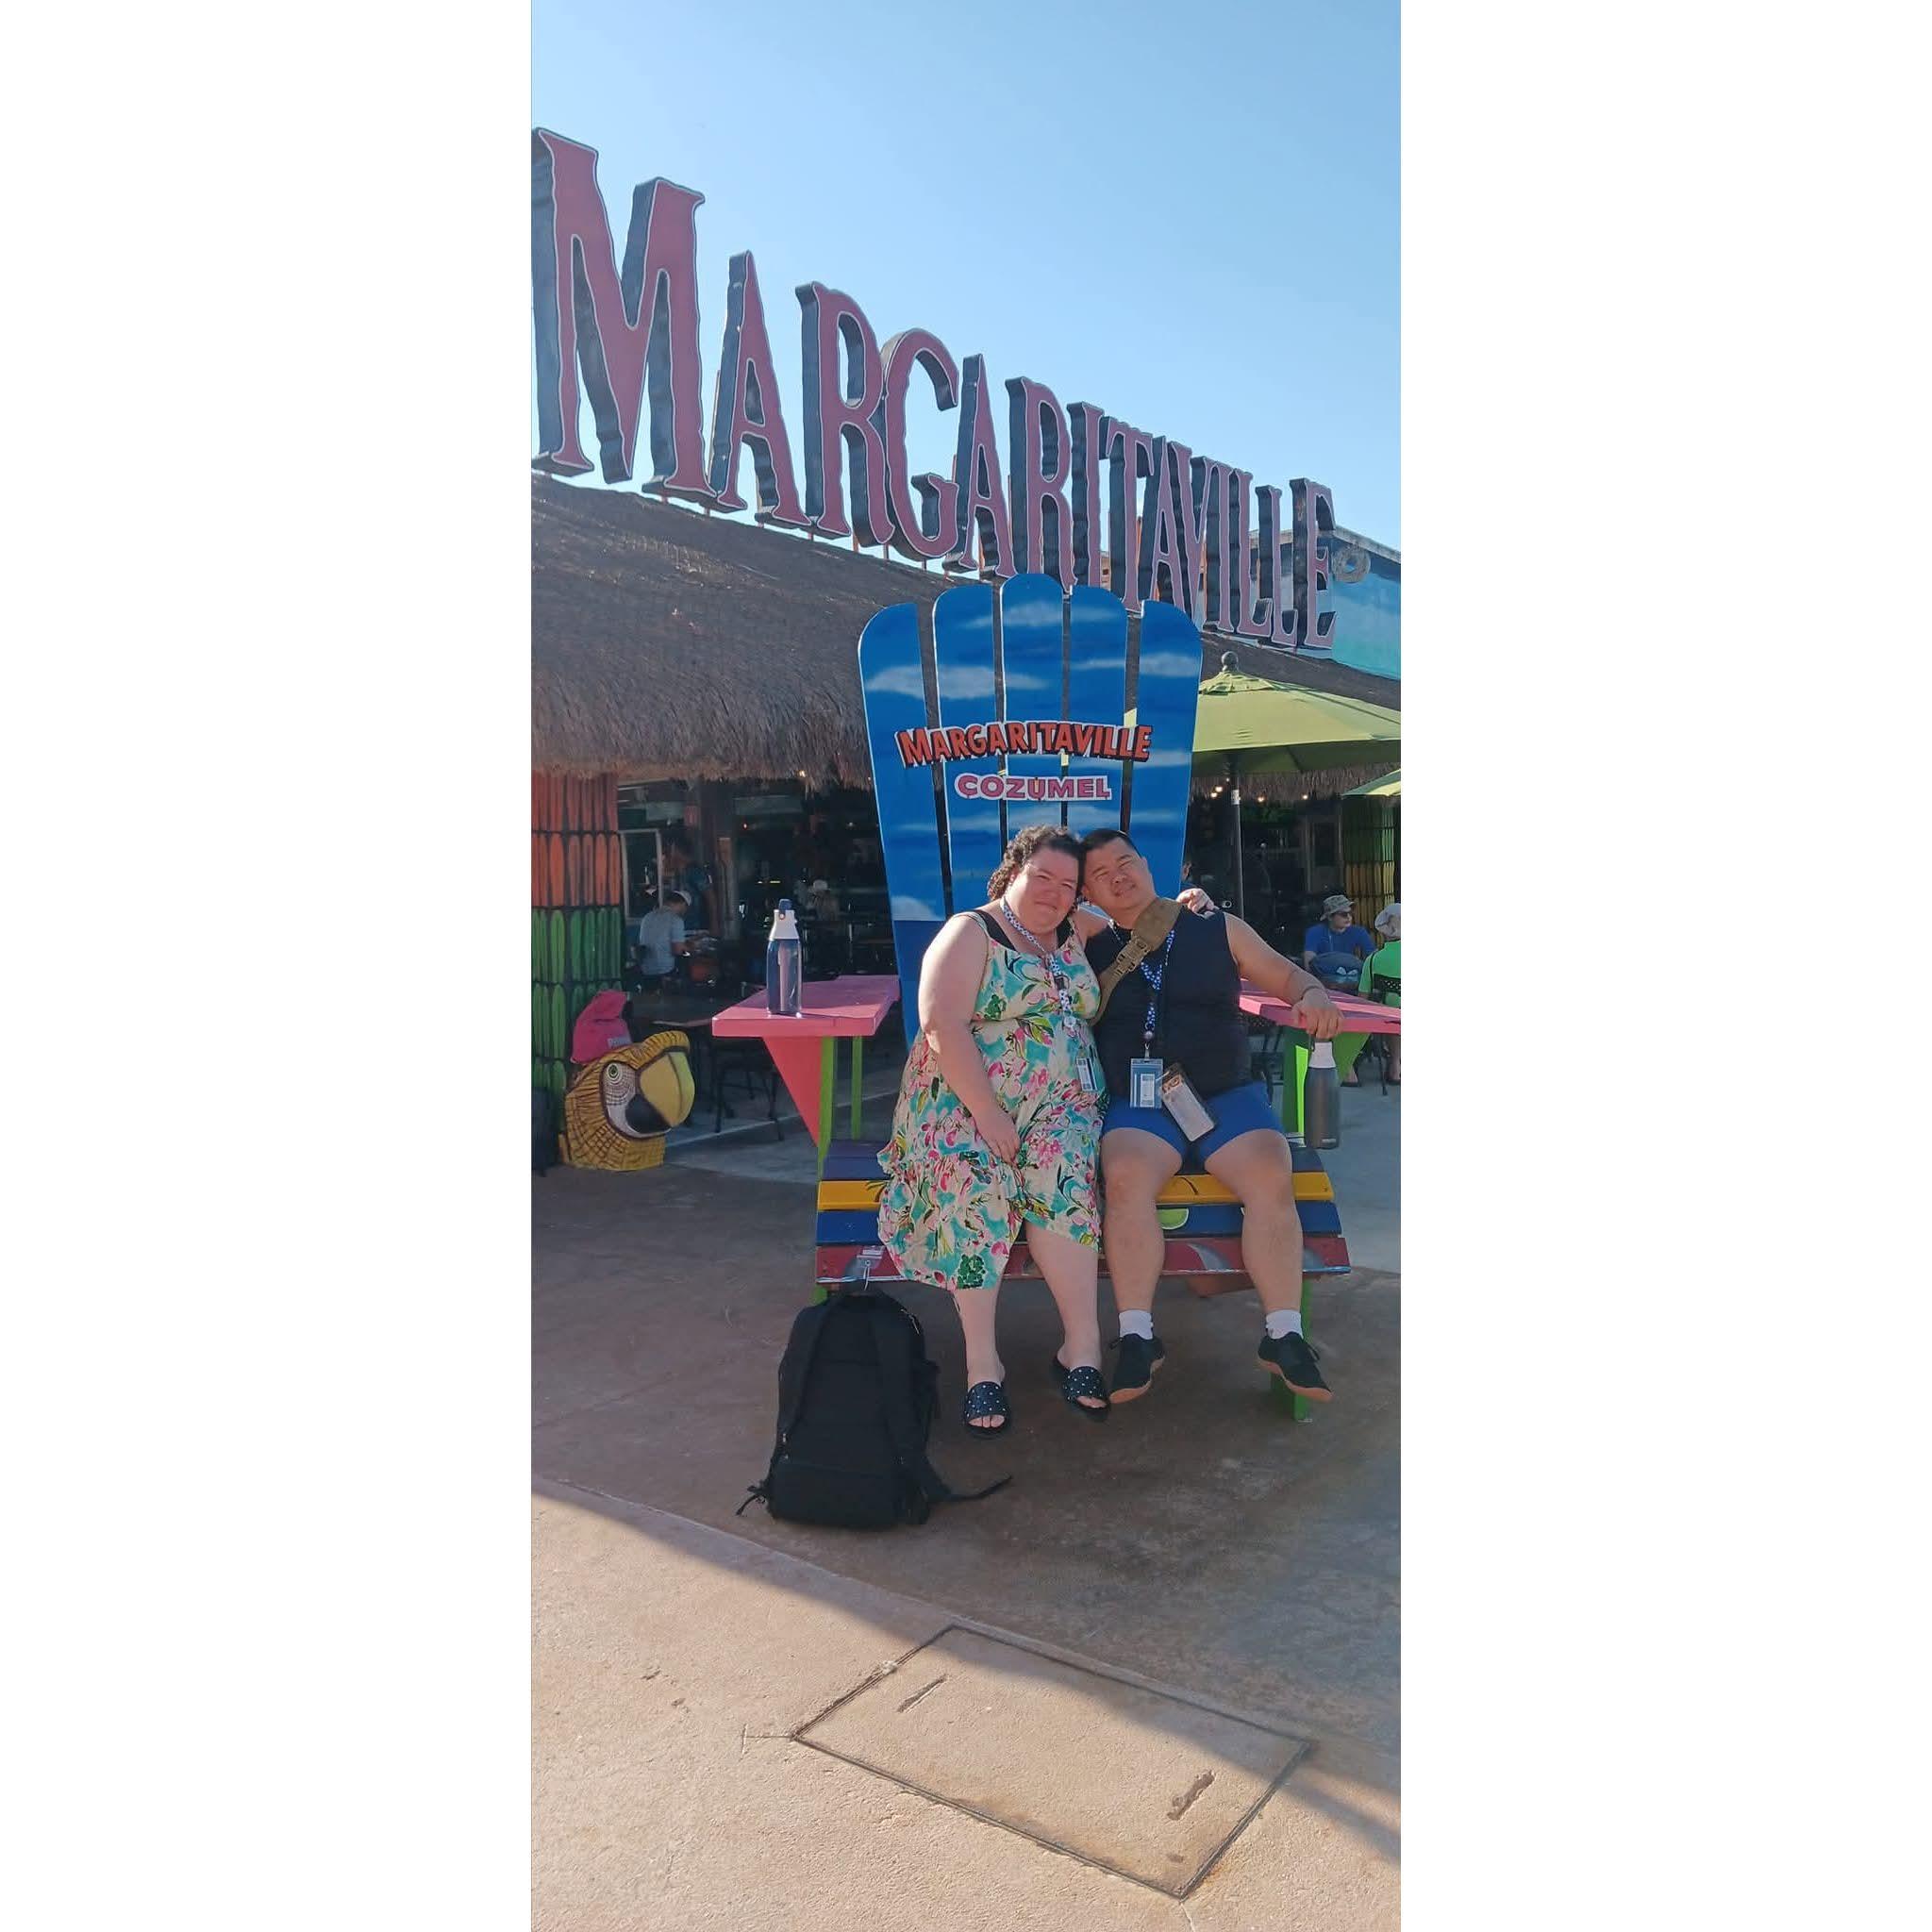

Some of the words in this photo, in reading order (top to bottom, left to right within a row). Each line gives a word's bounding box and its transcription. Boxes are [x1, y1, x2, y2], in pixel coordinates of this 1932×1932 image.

[531, 127, 1337, 650] MARGARITAVILLE
[897, 723, 1153, 767] MARGARITAVILLE
[957, 774, 1111, 800] COZUMEL
